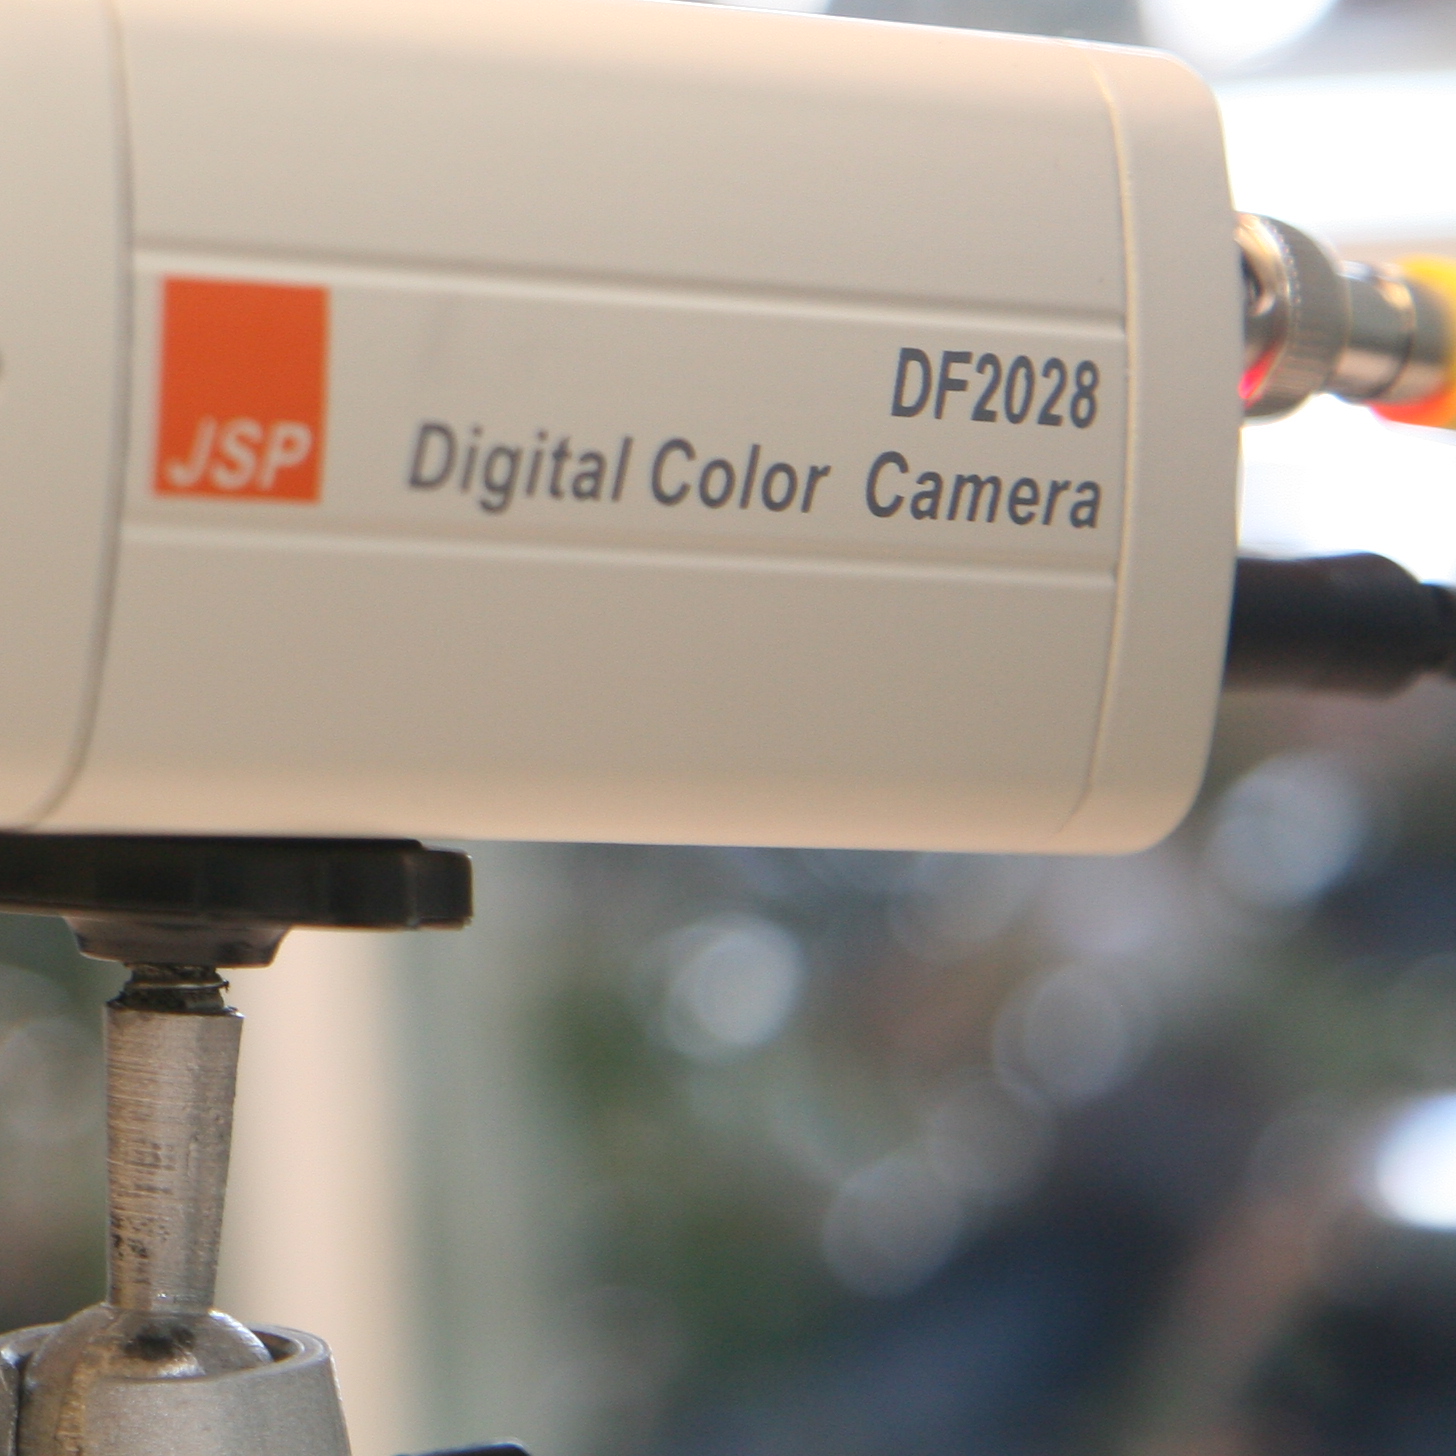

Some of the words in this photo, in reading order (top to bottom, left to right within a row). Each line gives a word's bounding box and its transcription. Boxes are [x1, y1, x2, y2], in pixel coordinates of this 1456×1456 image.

[890, 346, 1100, 430] DF2028
[165, 416, 314, 490] JSP
[407, 420, 634, 514] Digital
[650, 437, 832, 514] Color
[865, 450, 1103, 530] Camera
